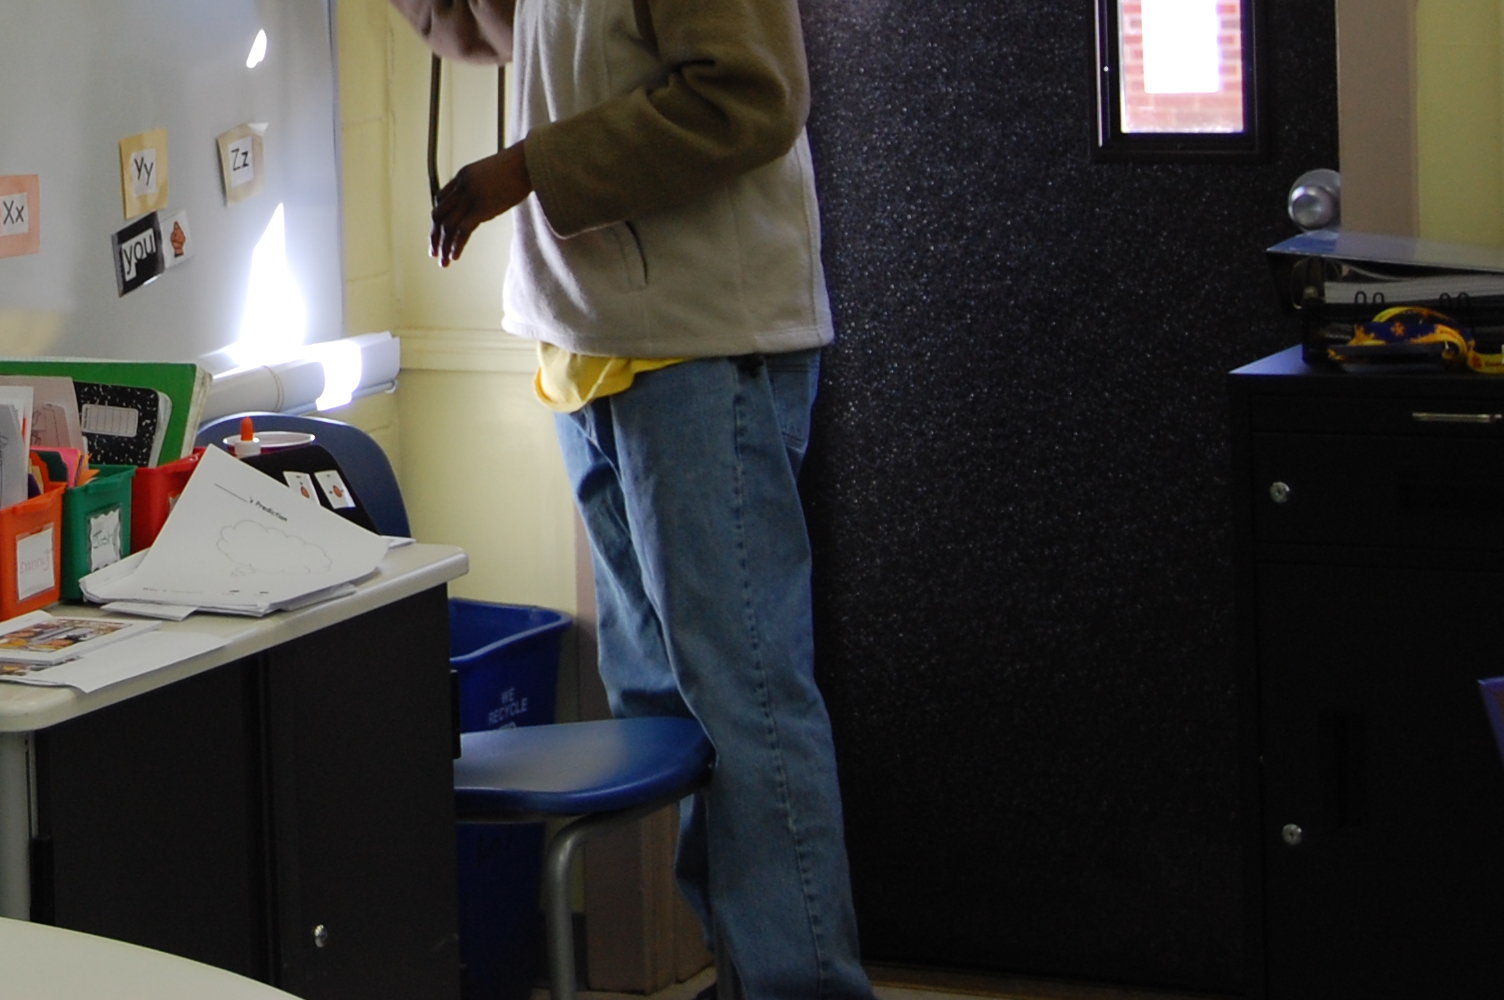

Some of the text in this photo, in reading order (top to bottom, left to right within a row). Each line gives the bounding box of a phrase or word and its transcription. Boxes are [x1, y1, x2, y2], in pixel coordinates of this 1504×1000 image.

[133, 156, 154, 186] Yy
[230, 147, 250, 172] Zz
[2, 199, 25, 225] Xx
[123, 235, 156, 275] you
[501, 687, 515, 705] WE
[488, 697, 528, 725] RECYCLE
